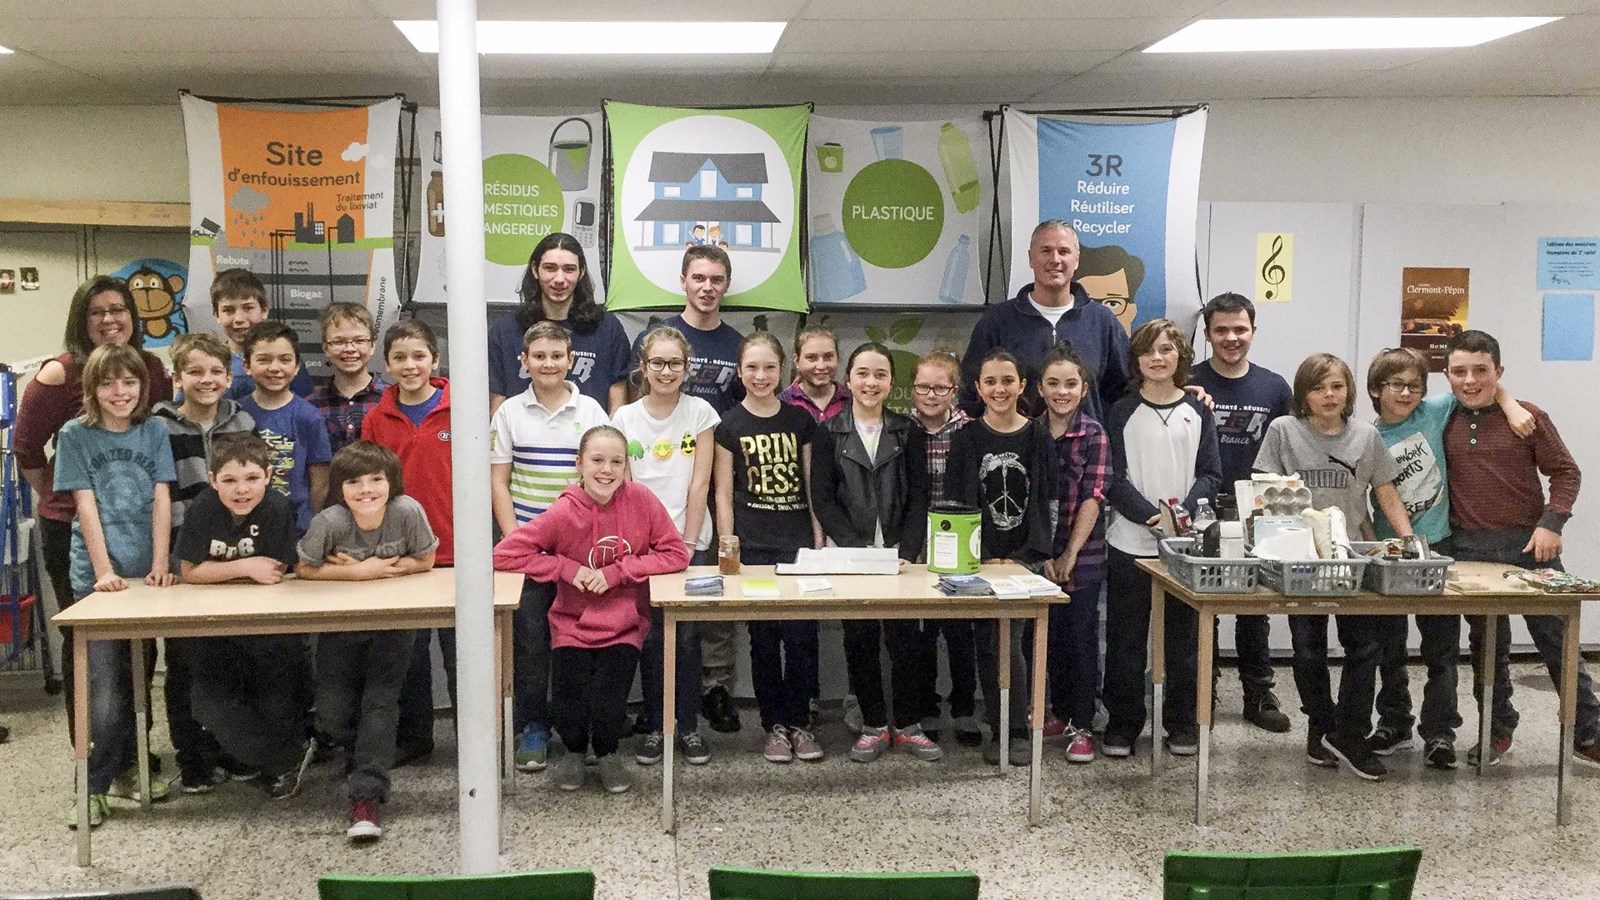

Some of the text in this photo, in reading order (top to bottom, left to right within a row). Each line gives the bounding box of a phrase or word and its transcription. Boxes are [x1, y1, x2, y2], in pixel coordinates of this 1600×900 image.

[266, 141, 323, 166] Site
[1086, 154, 1123, 177] 3R
[228, 168, 361, 187] d'enfouissement
[484, 180, 539, 197] RÉSIDUS
[1077, 180, 1130, 195] Réduire
[336, 192, 384, 203] Traitement
[484, 203, 558, 218] MESTIQUES
[852, 205, 935, 221] PLASTIQUE
[1071, 199, 1135, 214] Réutiliser
[484, 222, 552, 236] ANGEREUX
[1073, 219, 1131, 236] Recycler
[216, 255, 249, 265] Rebuts
[290, 289, 322, 300] Biogaz
[1407, 285, 1465, 295] Clermont-Pépin
[739, 432, 798, 466] PRIN
[747, 462, 800, 495] CESS
[250, 524, 259, 536] C
